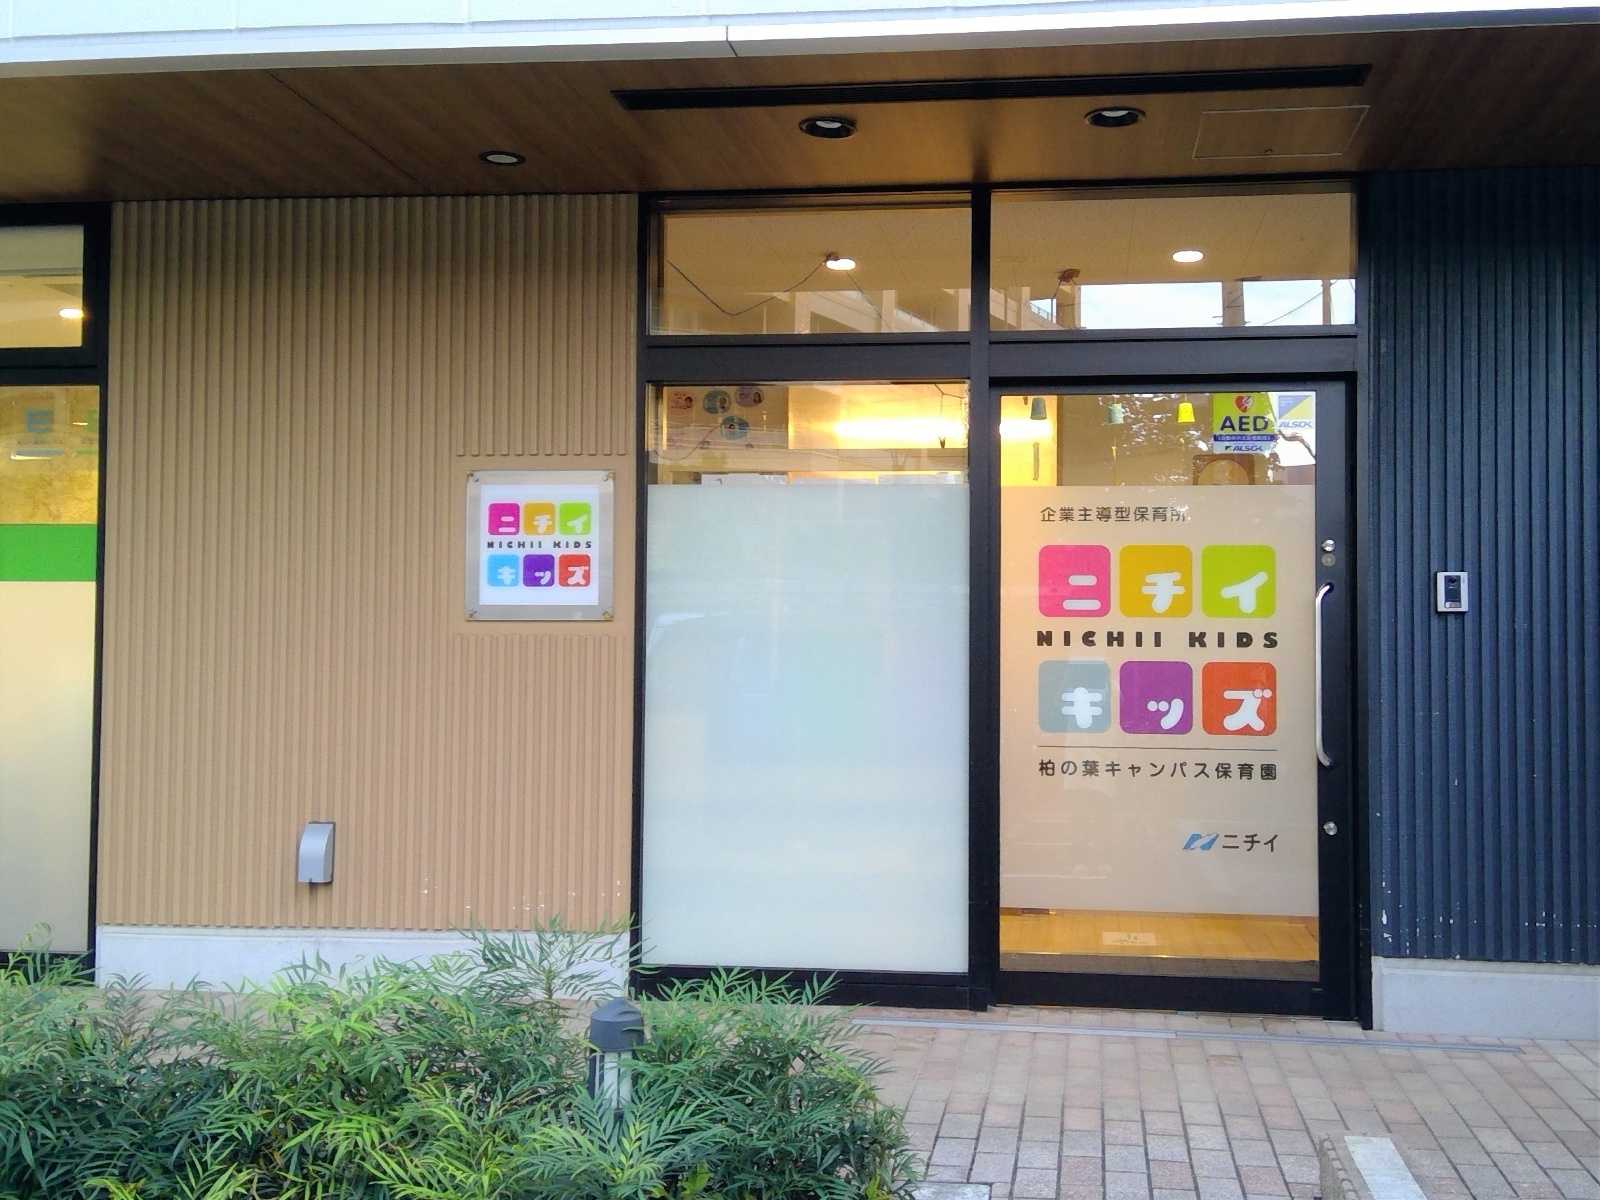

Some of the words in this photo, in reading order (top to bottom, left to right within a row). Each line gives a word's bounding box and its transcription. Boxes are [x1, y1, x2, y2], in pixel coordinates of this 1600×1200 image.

[1220, 415, 1269, 432] AED
[497, 513, 589, 534] ニチイ
[487, 540, 543, 549] NICHII
[553, 540, 592, 549] KIDS
[1060, 568, 1271, 615] ニチイ
[1036, 630, 1162, 648] NICHII
[1188, 631, 1279, 649] KIDS
[1059, 684, 1274, 733] キッズ
[1037, 759, 1278, 781] 柏の葉キャンパス保育園
[1222, 833, 1279, 853] ニチイ
